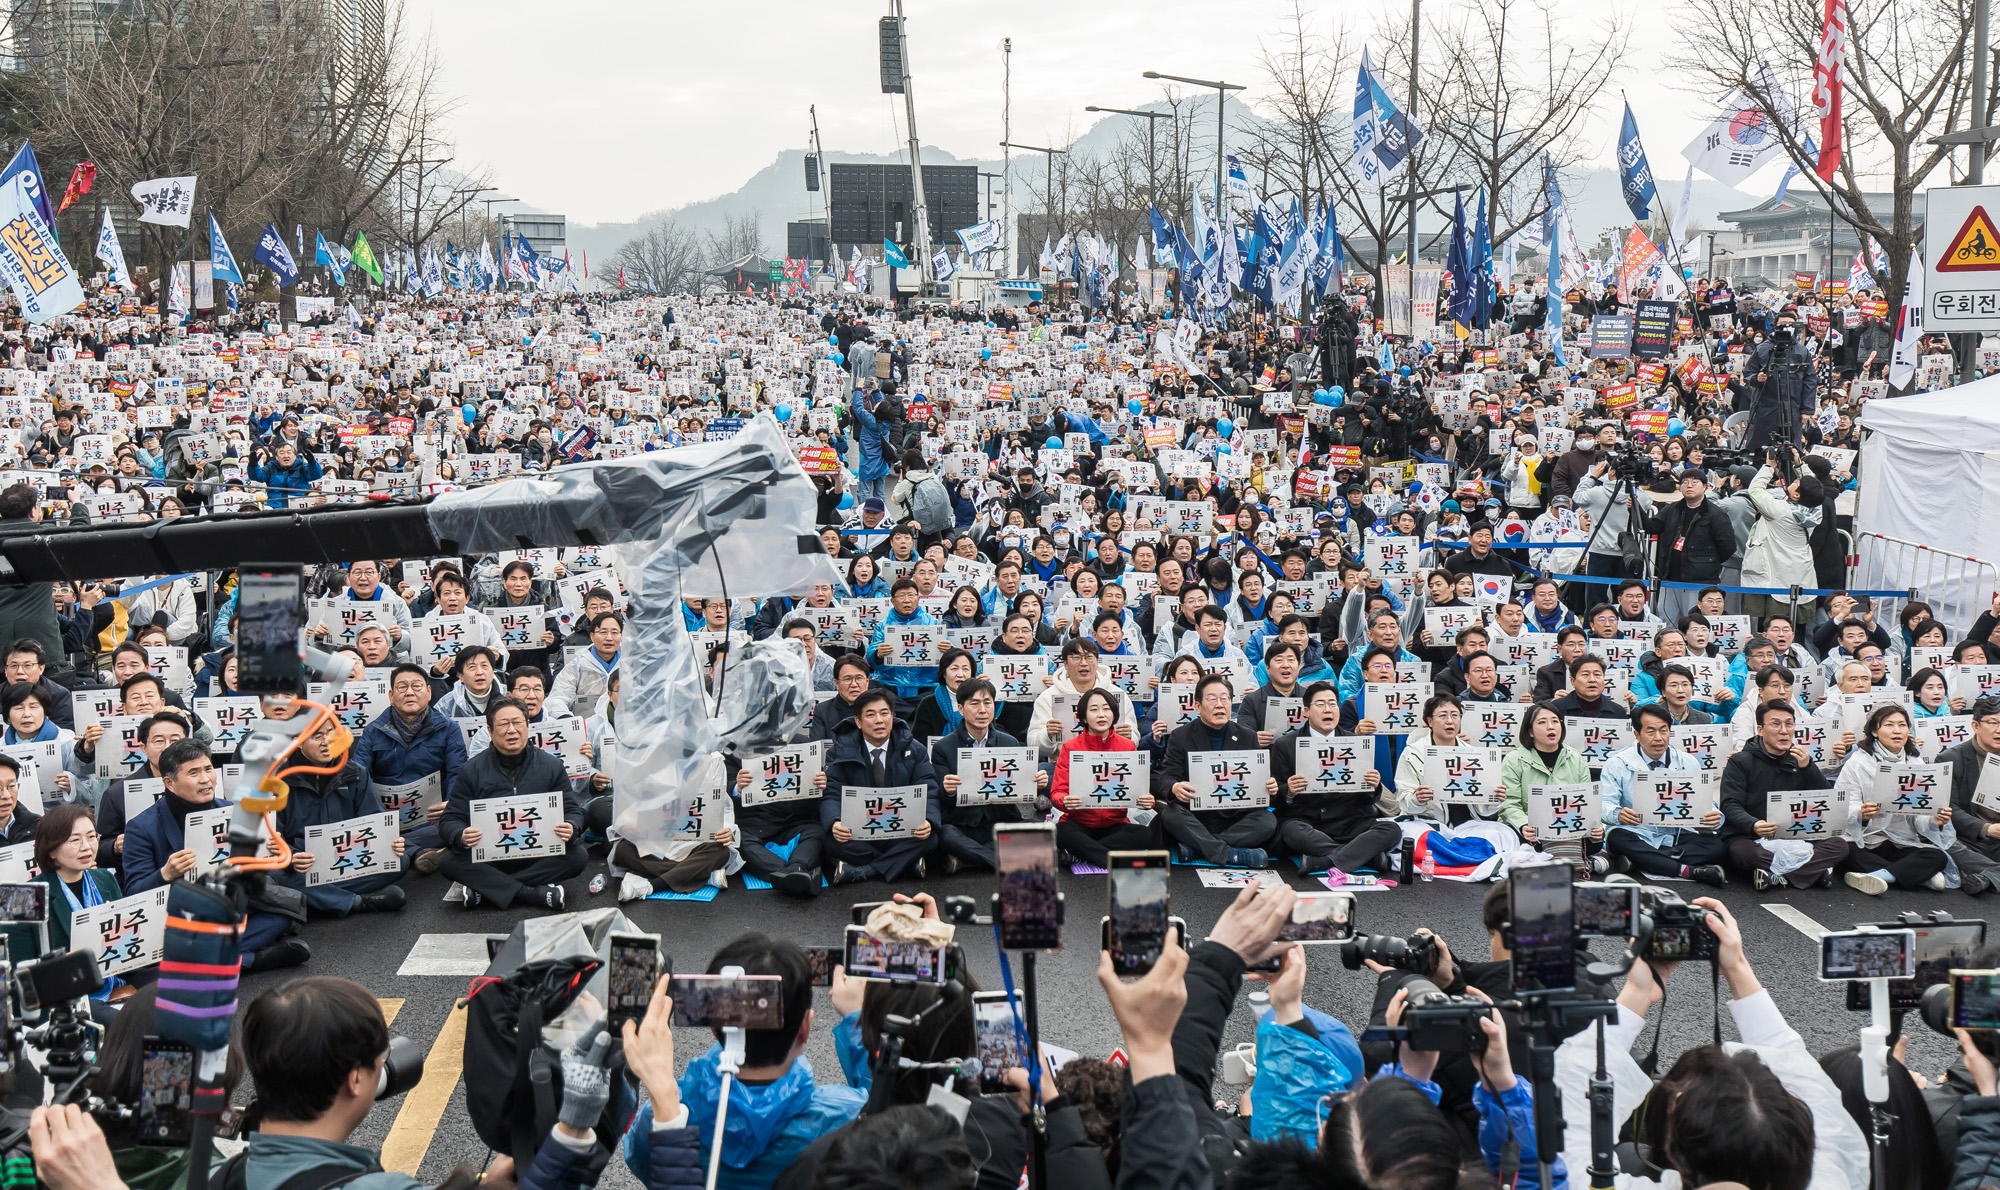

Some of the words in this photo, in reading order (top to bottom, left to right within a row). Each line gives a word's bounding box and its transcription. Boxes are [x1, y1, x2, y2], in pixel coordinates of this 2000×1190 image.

[27, 210, 42, 229] 함께
[40, 229, 55, 246] 사는
[0, 213, 68, 296] 잼잼
[1937, 294, 2000, 315] 우회전
[1984, 352, 2000, 360] 민주
[299, 388, 315, 396] 민주
[611, 393, 625, 402] 민주
[1442, 394, 1460, 404] 민주
[1574, 392, 1590, 401] 민주
[1607, 393, 1636, 406] 파면하라!
[640, 398, 655, 407] 민주
[640, 405, 655, 413] 수호
[146, 409, 163, 417] 민주
[146, 416, 163, 425] 수호
[502, 416, 520, 426] 민주
[1453, 412, 1470, 422] 민주
[101, 422, 120, 431] 수호
[501, 424, 515, 435] 수호
[953, 425, 970, 434] 민주
[1008, 421, 1022, 429] 수호
[1453, 421, 1470, 429] 수호
[81, 440, 103, 450] 민주
[187, 440, 208, 451] 민주
[953, 433, 970, 442] 수호
[1071, 436, 1087, 445] 민주
[1253, 433, 1269, 441] 민주
[800, 450, 821, 458] 윤석열
[1071, 444, 1086, 452] 수호
[1254, 442, 1270, 450] 수호
[81, 450, 103, 460] 수호
[191, 450, 210, 460] 수호
[961, 457, 981, 468] 민주
[469, 460, 492, 471] 민주
[800, 460, 821, 469] 국힘당
[961, 467, 979, 476] 수호
[1129, 466, 1148, 475] 민주
[1426, 467, 1442, 476] 민주
[387, 478, 407, 487] 민주
[1130, 475, 1148, 484] 수호
[1272, 474, 1288, 483] 민주
[1179, 507, 1203, 520] 민주
[1284, 512, 1304, 523] 민주
[1177, 520, 1202, 534] 수호
[515, 549, 544, 562] 민주
[1380, 544, 1408, 560] 민주
[957, 563, 981, 579] 민주
[1379, 560, 1408, 575] 수호
[1289, 587, 1315, 603] 민주
[340, 608, 377, 627] 민주
[500, 614, 532, 631] 민주
[817, 614, 848, 631] 민주
[1440, 613, 1469, 630] 민주
[429, 624, 465, 642] 민주
[500, 630, 532, 646] 수호
[815, 629, 845, 645] 수호
[1624, 629, 1652, 640] 민주
[1710, 622, 1740, 637] 민주
[900, 632, 933, 648] 민주
[960, 635, 990, 651] 민주
[1712, 637, 1739, 651] 수호
[429, 645, 460, 660] 수호
[900, 646, 931, 663] 수호
[1509, 645, 1538, 663] 민주
[1605, 646, 1637, 663] 민주
[1928, 654, 1955, 670] 민주
[1000, 663, 1033, 681] 민주
[1109, 663, 1140, 681] 민주
[1204, 665, 1234, 681] 민주
[1000, 681, 1033, 698] 수호
[1977, 673, 2000, 690] 민주
[331, 691, 372, 713] 민주
[1385, 692, 1420, 711] 민주
[215, 706, 258, 727] 민주
[1382, 712, 1418, 729] 수호
[1481, 711, 1517, 730] 민주
[528, 731, 567, 751] 민주
[1479, 729, 1515, 748] 수호
[1583, 727, 1620, 744] 민주
[1795, 726, 1827, 746] 민주
[1935, 725, 1969, 743] 민주
[1682, 735, 1717, 754] 민주
[1317, 746, 1357, 767] 민주
[1582, 746, 1609, 763] 수호
[762, 753, 804, 776] 내란
[979, 758, 1019, 778] 민주
[1091, 758, 1132, 782] 민주
[1211, 761, 1251, 782] 민주
[1444, 756, 1484, 777] 민주
[1316, 767, 1356, 788] 수호
[1898, 773, 1937, 792] 민주
[761, 775, 802, 798] 종식
[977, 780, 1018, 800] 수호
[1089, 783, 1131, 804] 수호
[1210, 783, 1251, 804] 수호
[1443, 778, 1483, 799] 수호
[1655, 780, 1695, 801] 민주
[380, 790, 424, 813] 민주
[864, 796, 907, 816] 민주
[1550, 794, 1588, 814] 민주
[1789, 800, 1830, 820] 민주
[1891, 793, 1933, 811] 수호
[495, 807, 542, 831] 민주
[1653, 802, 1694, 822] 수호
[862, 816, 905, 836] 수호
[1549, 815, 1587, 836] 수호
[1785, 820, 1827, 837] 수호
[331, 827, 378, 853] 민주
[495, 830, 543, 854] 수호
[329, 849, 378, 876] 수호
[99, 908, 148, 942] 민주
[98, 937, 146, 972] 수호
